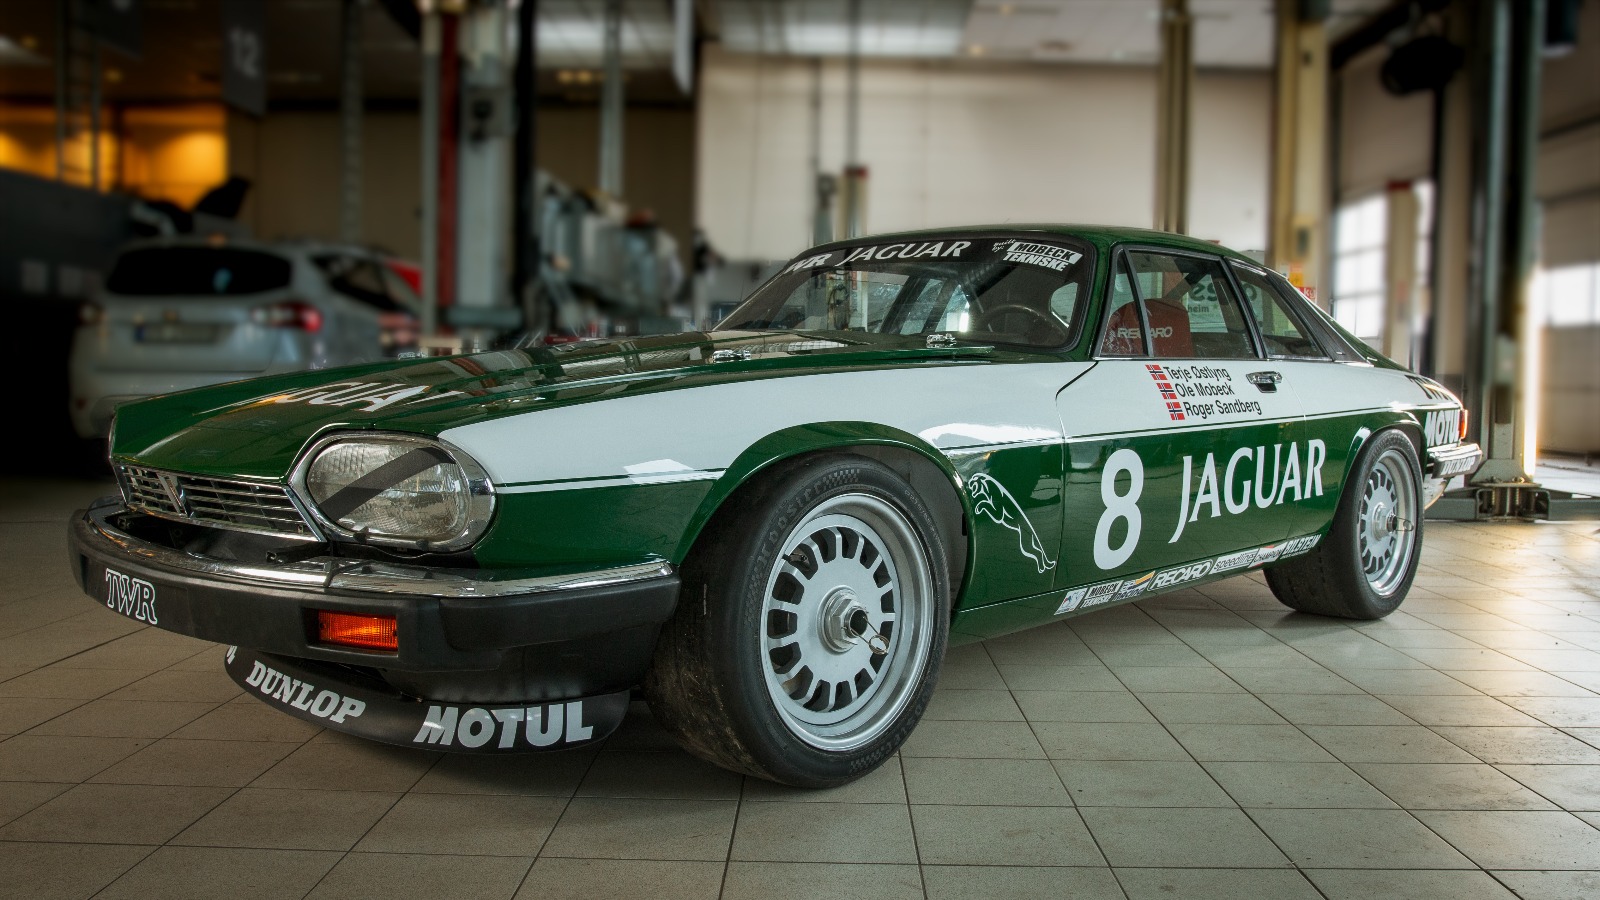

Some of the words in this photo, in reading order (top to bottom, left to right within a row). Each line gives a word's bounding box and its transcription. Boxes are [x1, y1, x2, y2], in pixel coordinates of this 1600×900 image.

[834, 241, 971, 267] JAGUAR
[1003, 252, 1069, 271] TEKNISKE
[1014, 243, 1076, 262] MOBECK
[1117, 326, 1173, 339] REARO
[1163, 366, 1192, 382] Terje
[1190, 365, 1232, 381] Østlyng
[1175, 383, 1195, 397] Ole
[1194, 382, 1235, 397] Mobeck
[1183, 401, 1215, 419] Roger
[1215, 399, 1262, 415] Sandberg
[1425, 409, 1460, 447] MOTUL
[1168, 438, 1326, 543] JAGUAR
[1093, 448, 1144, 570] 8
[1151, 563, 1211, 589] RECARO
[105, 567, 158, 625] TWR
[245, 660, 367, 724] DUNLOP
[412, 700, 594, 749] MOTUL
